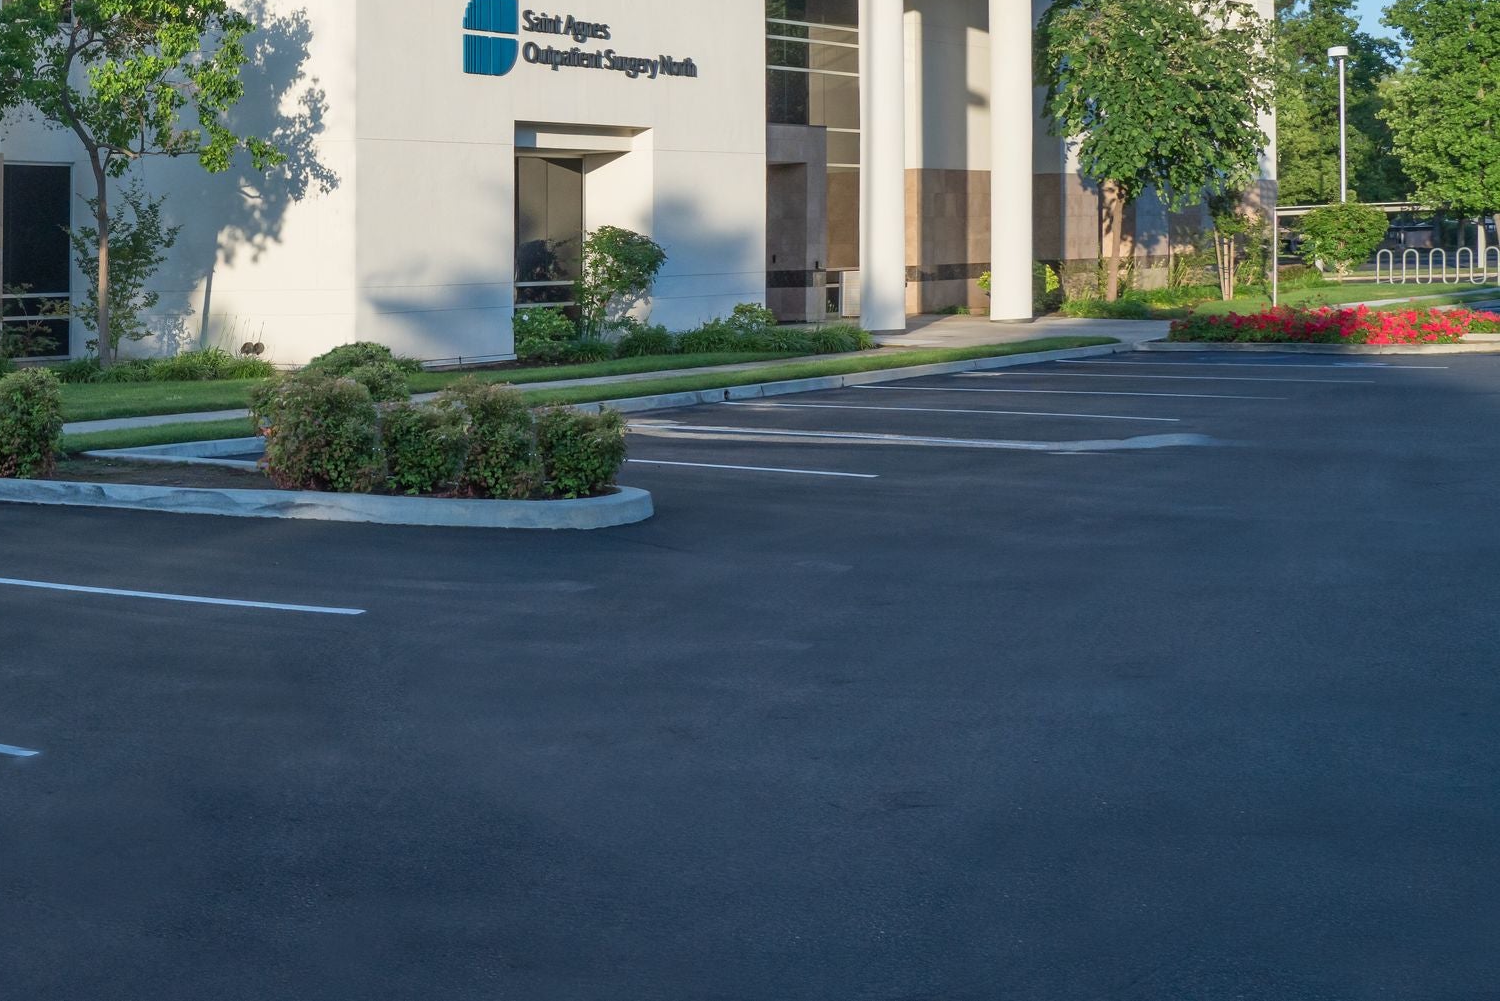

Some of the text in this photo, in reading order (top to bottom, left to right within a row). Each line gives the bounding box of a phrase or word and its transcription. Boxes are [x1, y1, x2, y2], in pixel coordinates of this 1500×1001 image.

[522, 9, 612, 44] Saint Agnes
[522, 41, 698, 80] Outpatient Surgery North
